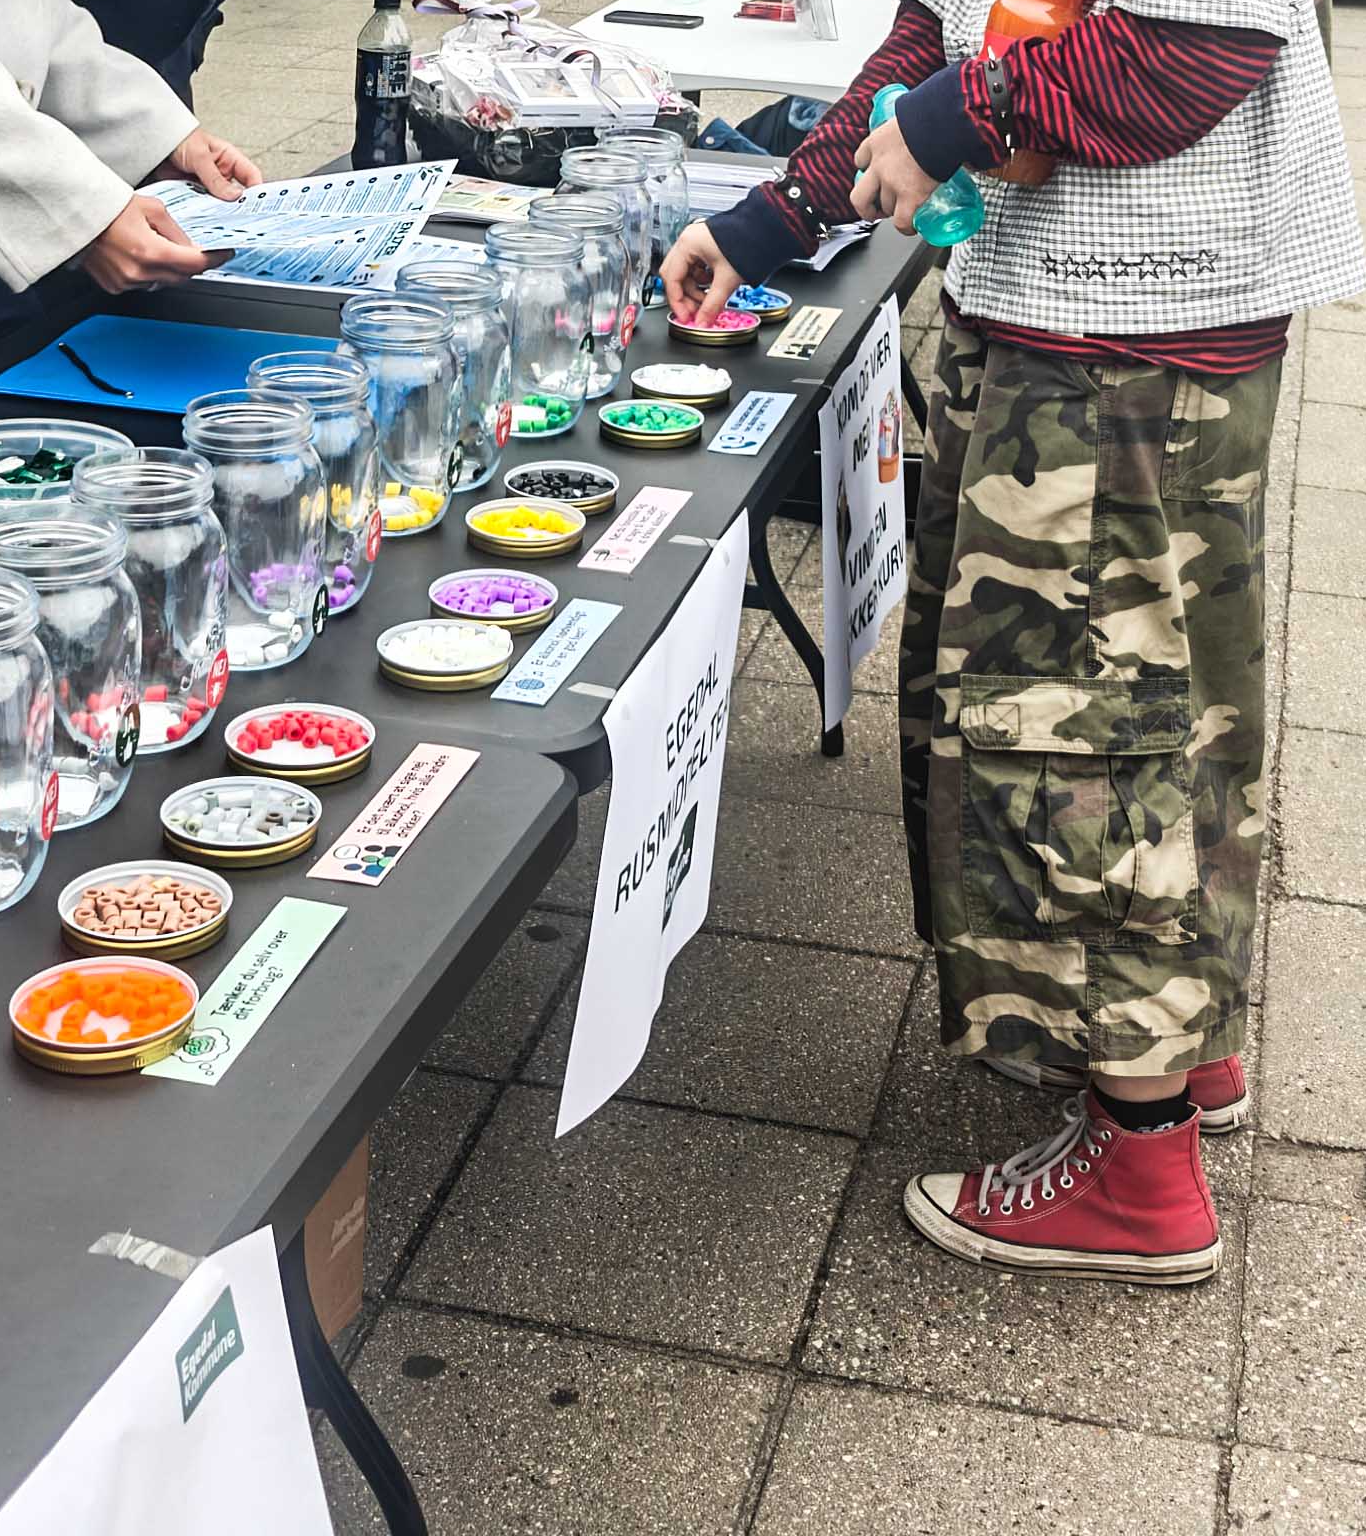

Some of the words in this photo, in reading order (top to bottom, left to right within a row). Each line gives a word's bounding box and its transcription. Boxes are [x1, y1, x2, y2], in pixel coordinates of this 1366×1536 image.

[667, 652, 719, 772] EGEDAL
[210, 981, 248, 1017] Tænker
[242, 967, 260, 981] du
[254, 948, 273, 969] selv
[267, 929, 289, 949] over
[234, 1004, 250, 1021] dit
[242, 965, 284, 1007] forbrug?
[182, 1318, 217, 1385] Egedal
[184, 1328, 237, 1407] Kommune
